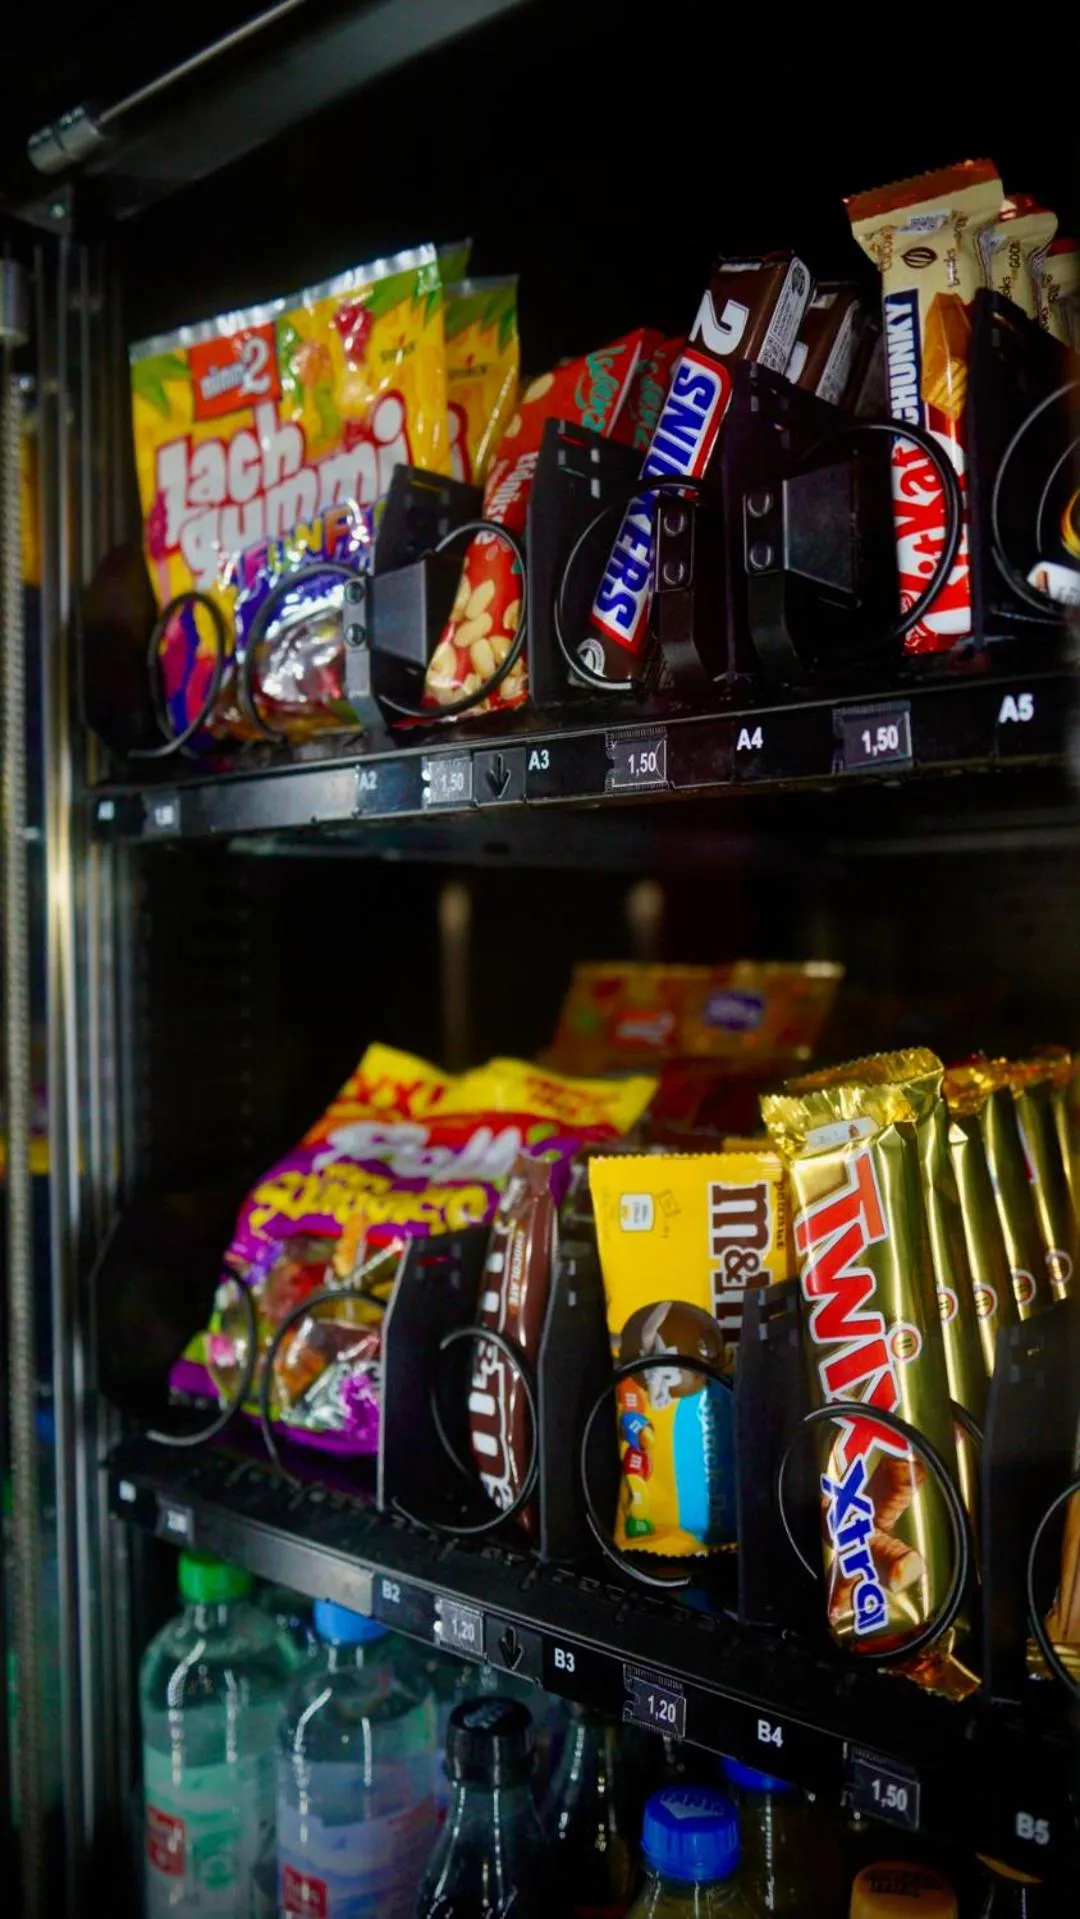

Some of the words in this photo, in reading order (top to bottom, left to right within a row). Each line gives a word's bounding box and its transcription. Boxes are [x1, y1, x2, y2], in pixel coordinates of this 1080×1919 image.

[688, 289, 749, 355] 2
[885, 301, 920, 425] CHUNKY
[181, 394, 412, 588] gummi
[1000, 693, 1034, 723] A5
[737, 727, 763, 750] A4
[862, 726, 898, 755] 1,50
[528, 750, 550, 770] A3
[627, 752, 657, 775] 1,50
[360, 773, 378, 791] A2
[794, 1145, 913, 1470] TWIX
[382, 1581, 400, 1602] B2
[451, 1618, 475, 1642] 1,20
[554, 1647, 575, 1673] B3
[646, 1694, 677, 1723] 1,20
[757, 1720, 784, 1748] B4
[871, 1779, 908, 1812] 1,50
[1015, 1812, 1051, 1845] B5
